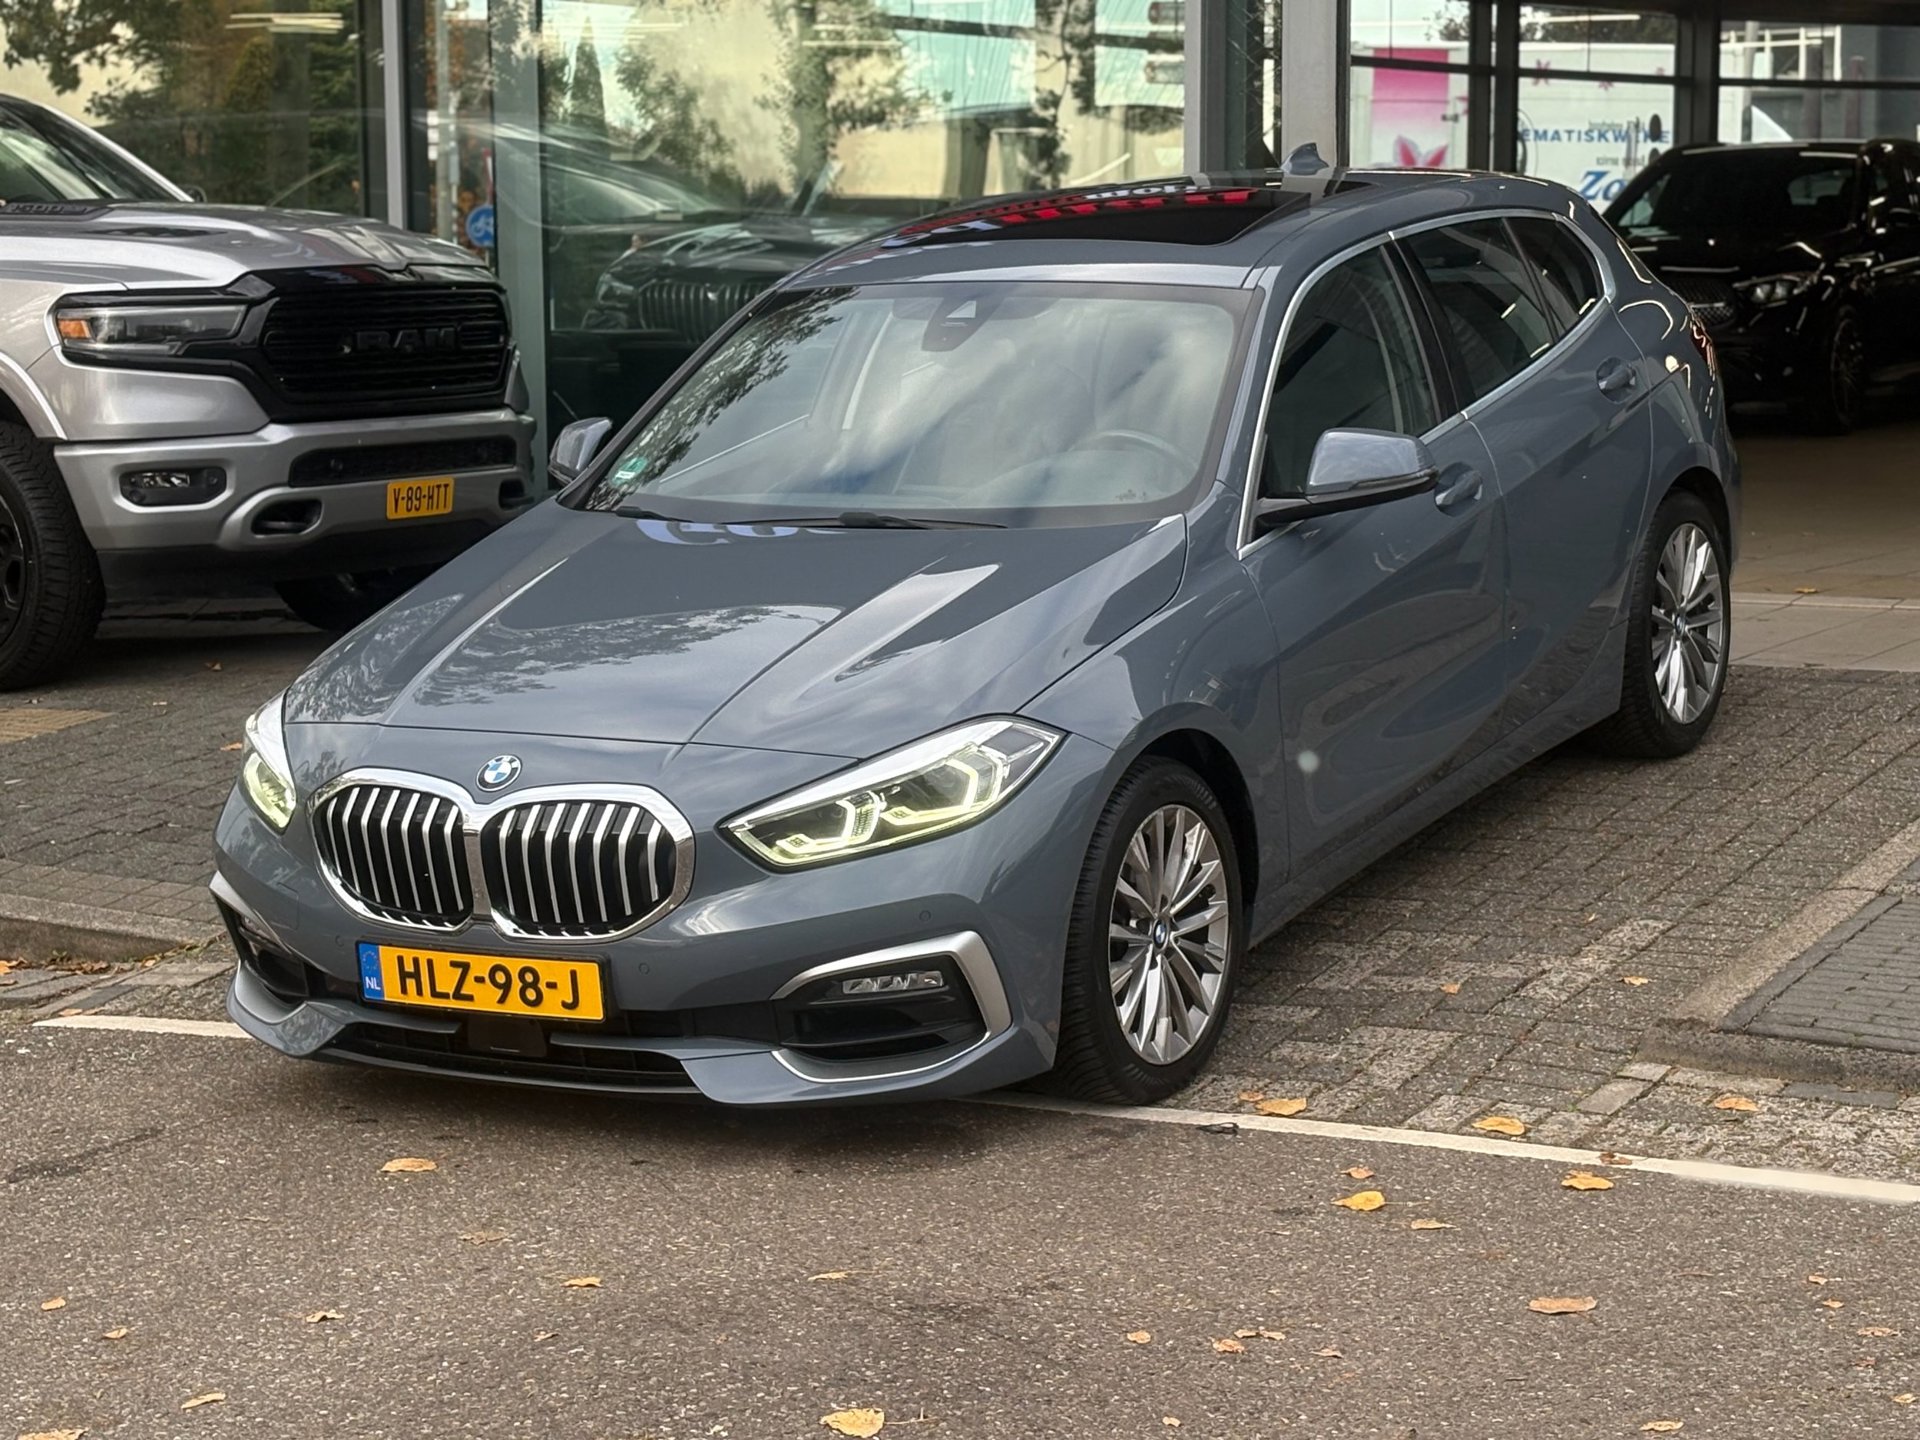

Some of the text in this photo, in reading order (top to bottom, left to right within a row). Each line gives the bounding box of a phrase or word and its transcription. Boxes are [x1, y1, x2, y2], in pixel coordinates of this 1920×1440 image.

[353, 327, 456, 353] RAM
[392, 483, 450, 513] V-89-HTT
[365, 976, 381, 991] NL
[397, 955, 580, 1010] HLZ-98-J
